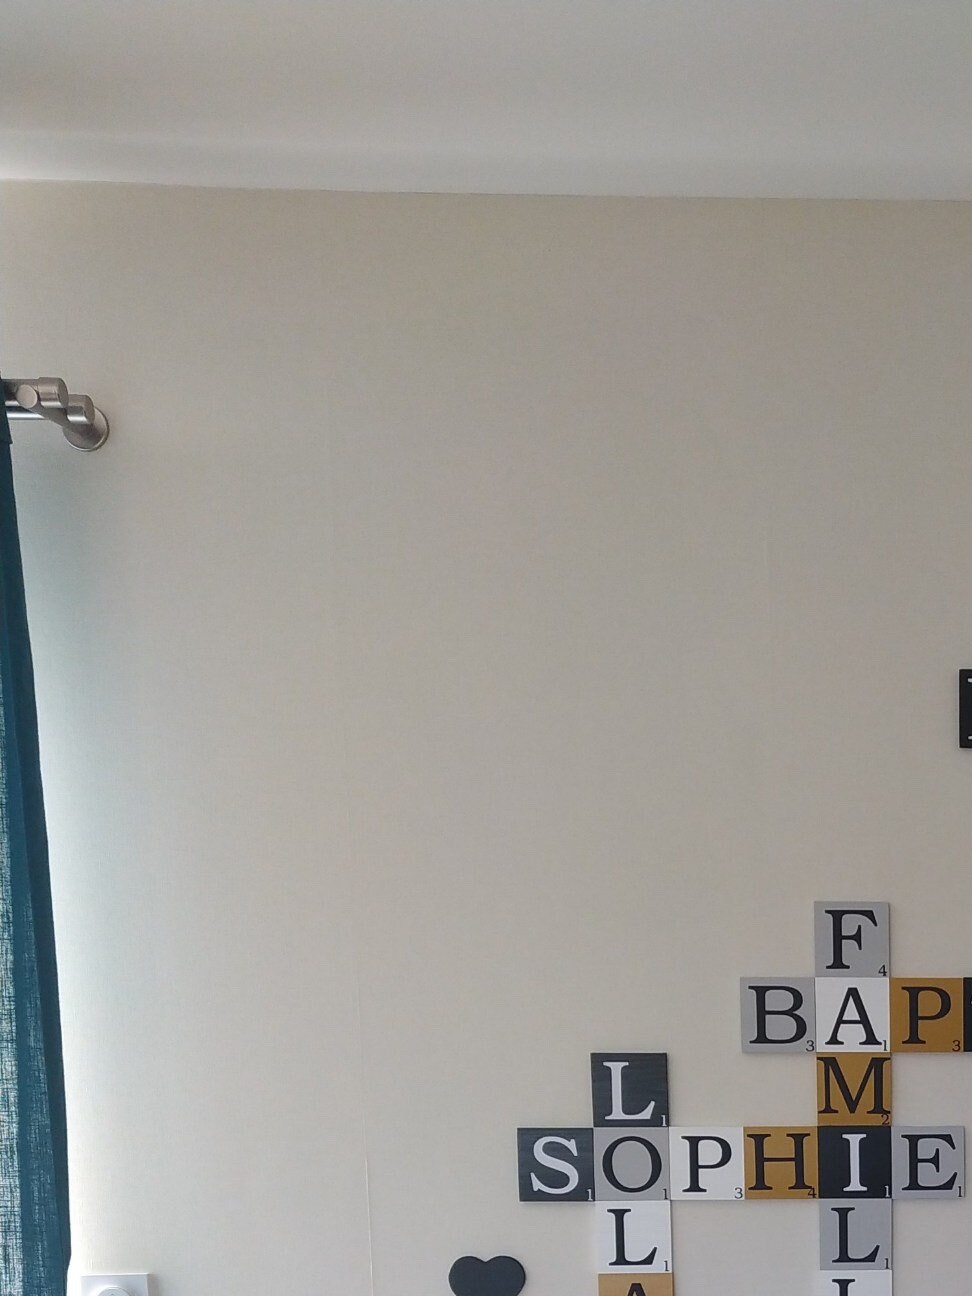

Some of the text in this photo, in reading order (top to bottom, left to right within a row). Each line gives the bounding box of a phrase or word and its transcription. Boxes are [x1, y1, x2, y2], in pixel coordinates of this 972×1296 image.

[878, 965, 888, 976] 4
[806, 1040, 815, 1052] 3
[952, 1040, 961, 1052] 3
[881, 1114, 890, 1125] 2
[530, 1133, 958, 1194] SOPHIE
[734, 1188, 743, 1199] 3
[808, 1187, 816, 1198] 4
